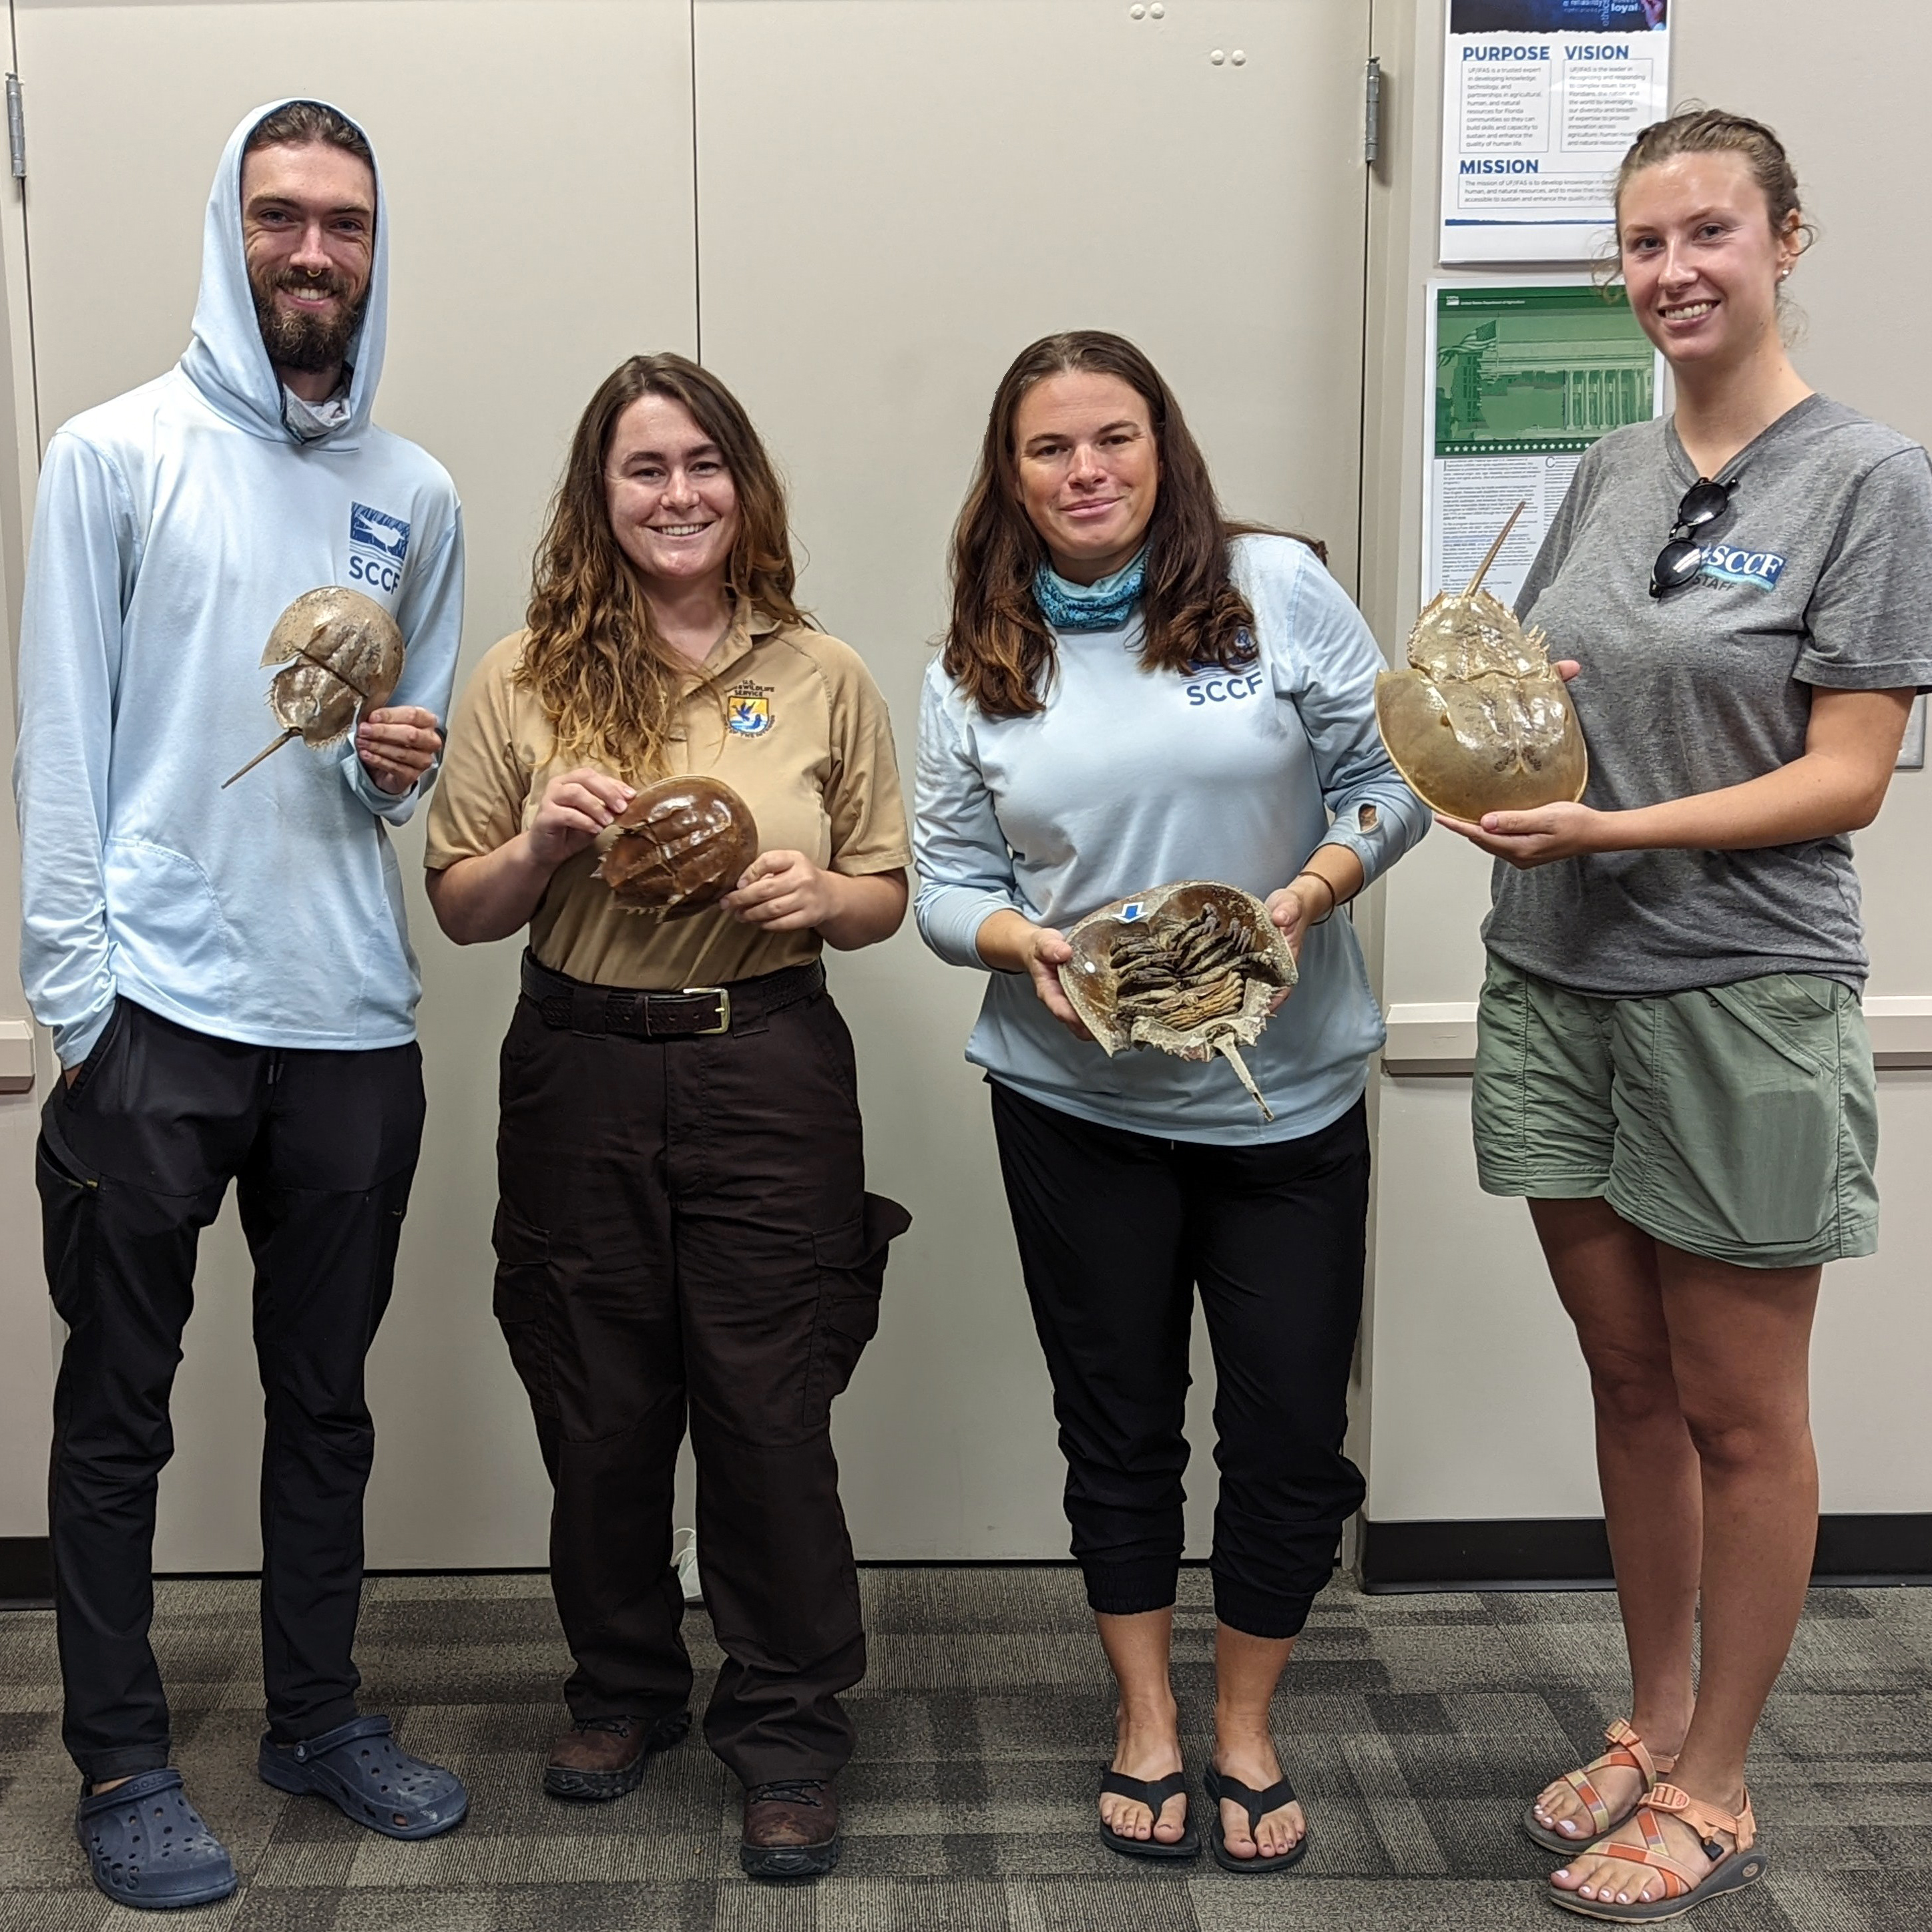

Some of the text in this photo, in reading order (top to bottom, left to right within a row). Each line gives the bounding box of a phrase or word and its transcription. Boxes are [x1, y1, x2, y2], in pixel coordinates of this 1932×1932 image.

[1611, 3, 1638, 13] loyal
[1463, 46, 1550, 61] PURPOSE
[1565, 45, 1629, 60] VISION
[1460, 159, 1539, 174] MISSION
[1708, 545, 1784, 577] SCCF
[348, 555, 401, 595] SCCF
[1692, 575, 1738, 591] STAFF
[1186, 671, 1263, 706] SCCF
